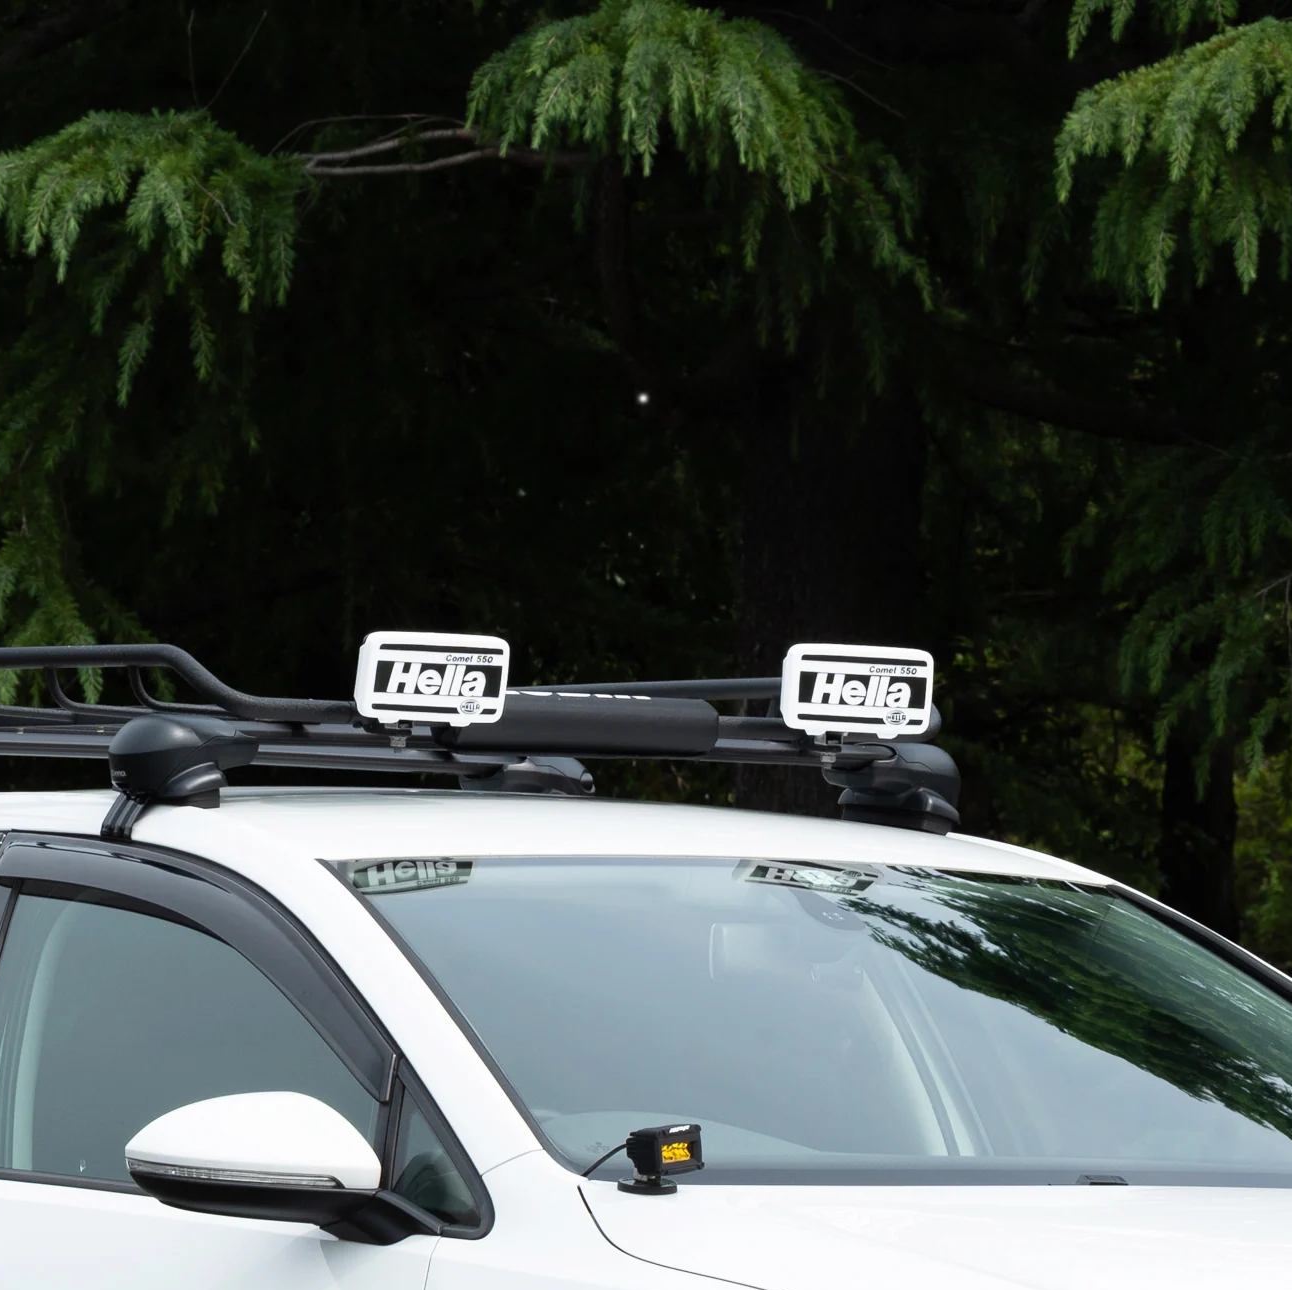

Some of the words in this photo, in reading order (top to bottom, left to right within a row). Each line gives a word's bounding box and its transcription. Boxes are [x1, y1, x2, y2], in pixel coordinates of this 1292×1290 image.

[445, 654, 473, 663] Comet
[476, 655, 494, 664] 550
[869, 665, 897, 674] Comet
[900, 666, 917, 675] 550
[386, 661, 487, 698] Hella
[810, 672, 912, 709] Hella
